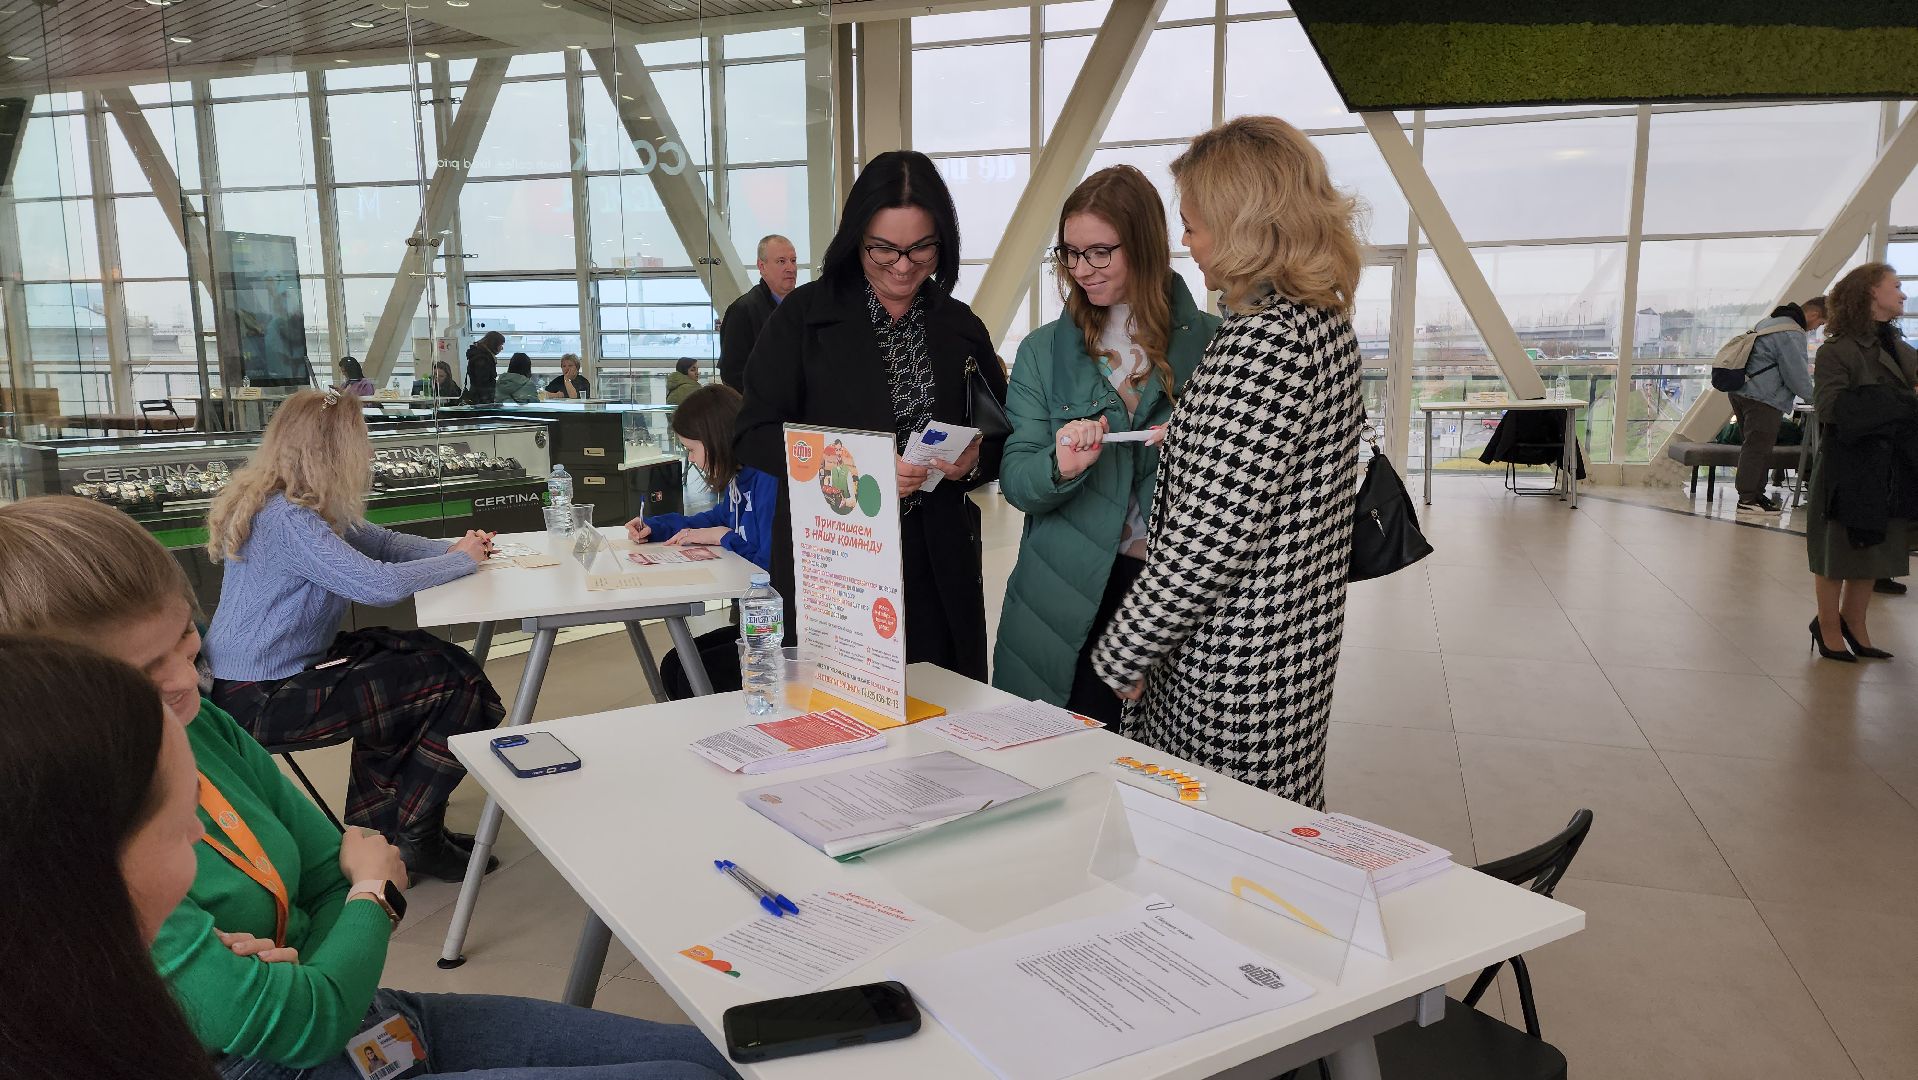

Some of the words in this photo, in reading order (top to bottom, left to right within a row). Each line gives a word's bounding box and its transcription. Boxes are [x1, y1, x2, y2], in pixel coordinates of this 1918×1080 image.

[370, 447, 438, 461] RTINA
[83, 463, 200, 482] CERTINA
[474, 492, 540, 507] CERTINA
[815, 515, 872, 538] Приглашаем
